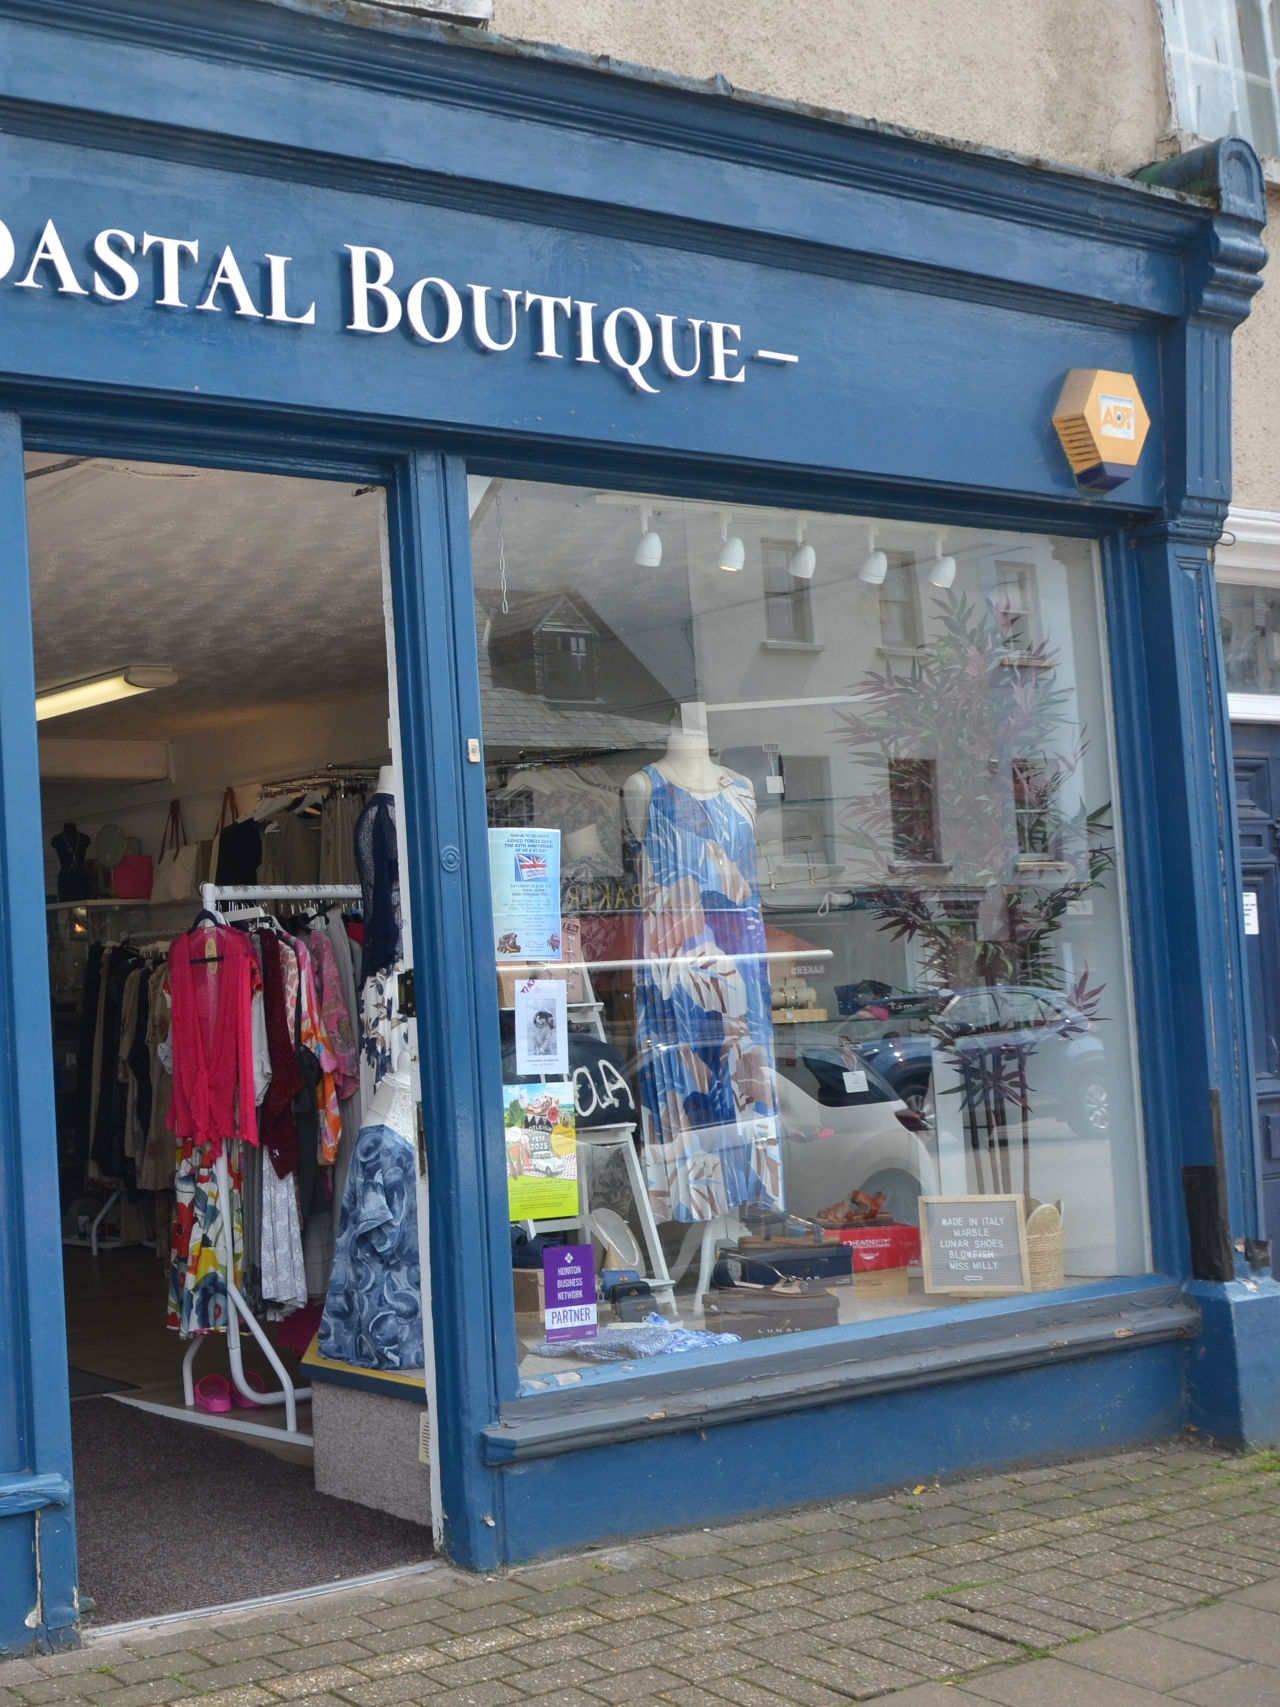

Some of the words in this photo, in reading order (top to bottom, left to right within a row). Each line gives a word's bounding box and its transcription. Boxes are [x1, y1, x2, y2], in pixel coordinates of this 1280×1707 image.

[343, 243, 745, 393] BOUTIQUE
[1101, 404, 1133, 430] ADT
[941, 1217, 963, 1226] MADE
[969, 1217, 978, 1226] IN
[982, 1216, 1005, 1226] ITALY
[953, 1228, 990, 1237] MARBLE
[939, 1239, 969, 1248] LUNAR
[974, 1239, 1004, 1248] SHOES
[557, 1265, 582, 1276] HONITON
[949, 1261, 970, 1271] MISS
[972, 1261, 999, 1270] MILLY
[556, 1277, 583, 1289] BUSINESS
[557, 1289, 584, 1301] NETWORK
[551, 1307, 591, 1325] PARTNER
